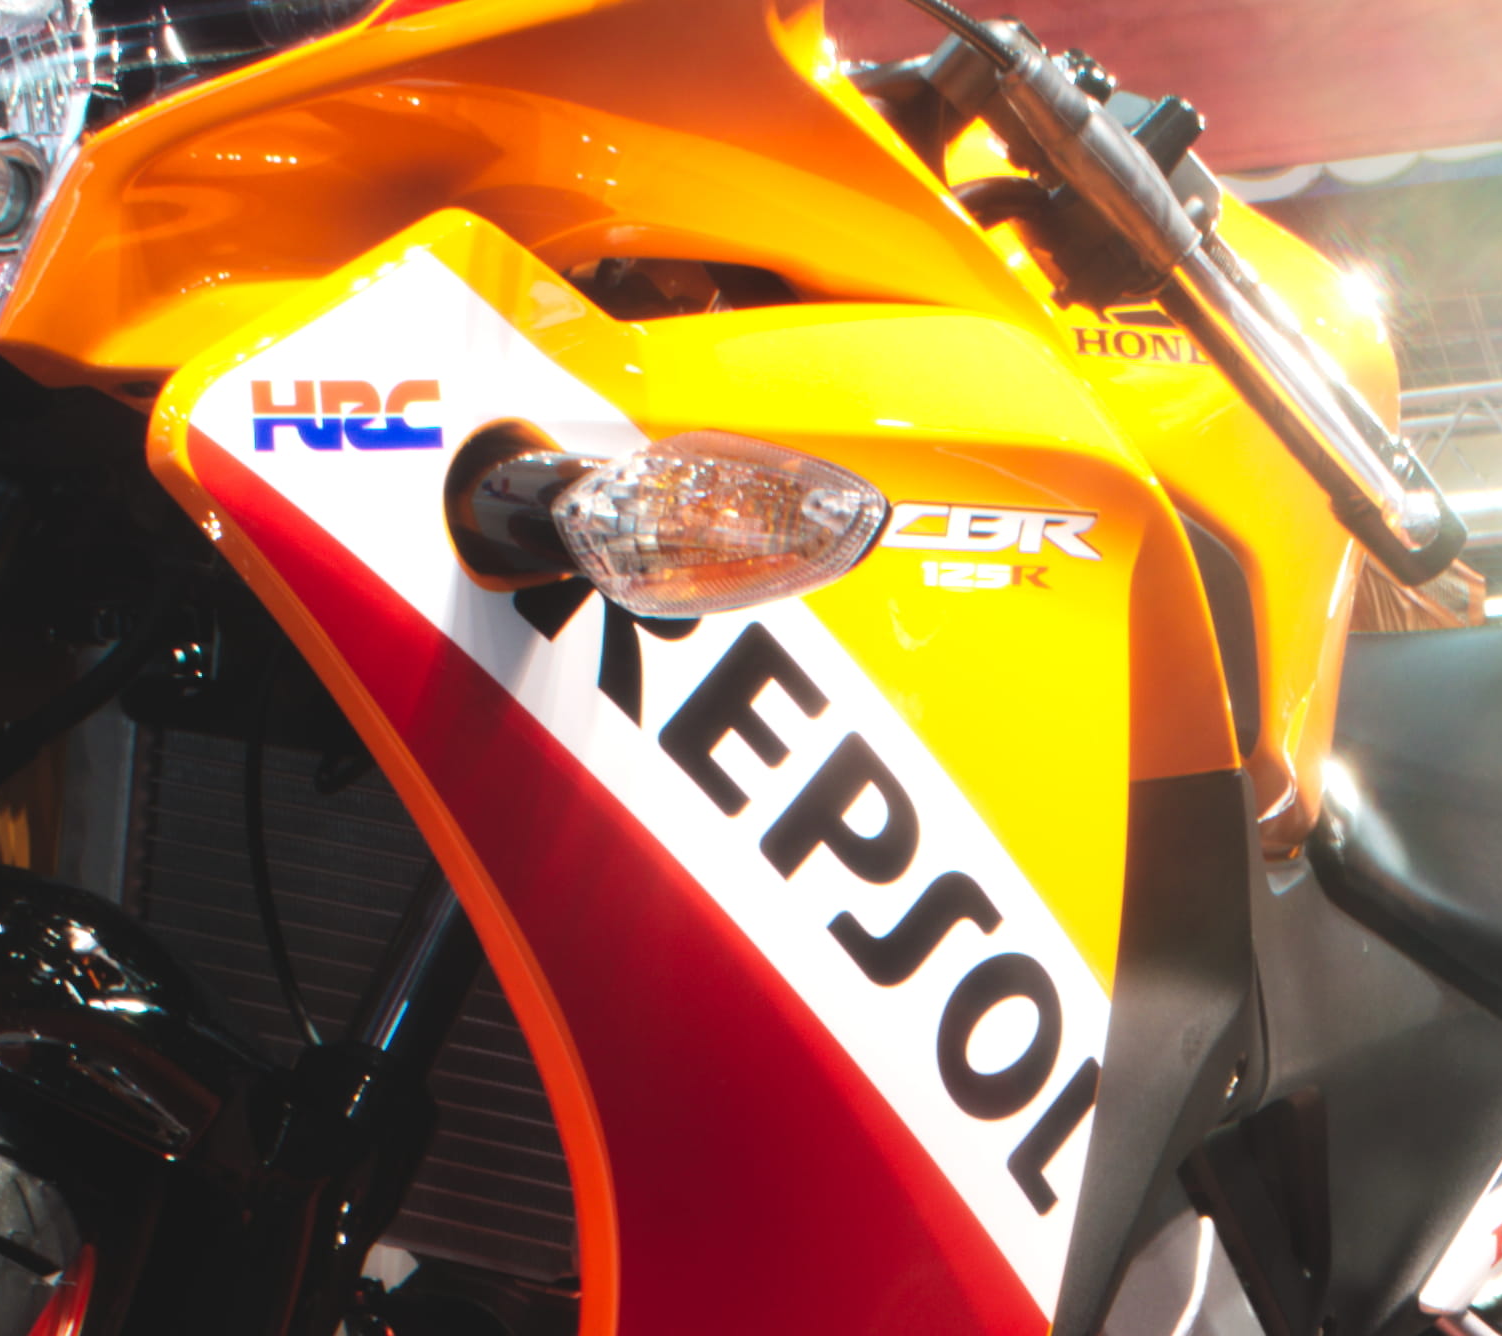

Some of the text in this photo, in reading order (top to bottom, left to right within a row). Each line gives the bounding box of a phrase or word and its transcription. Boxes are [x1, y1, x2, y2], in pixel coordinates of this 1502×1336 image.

[1072, 327, 1212, 366] HON
[250, 380, 444, 452] HRC
[883, 500, 1103, 561] CBR
[921, 560, 1054, 591] 125R
